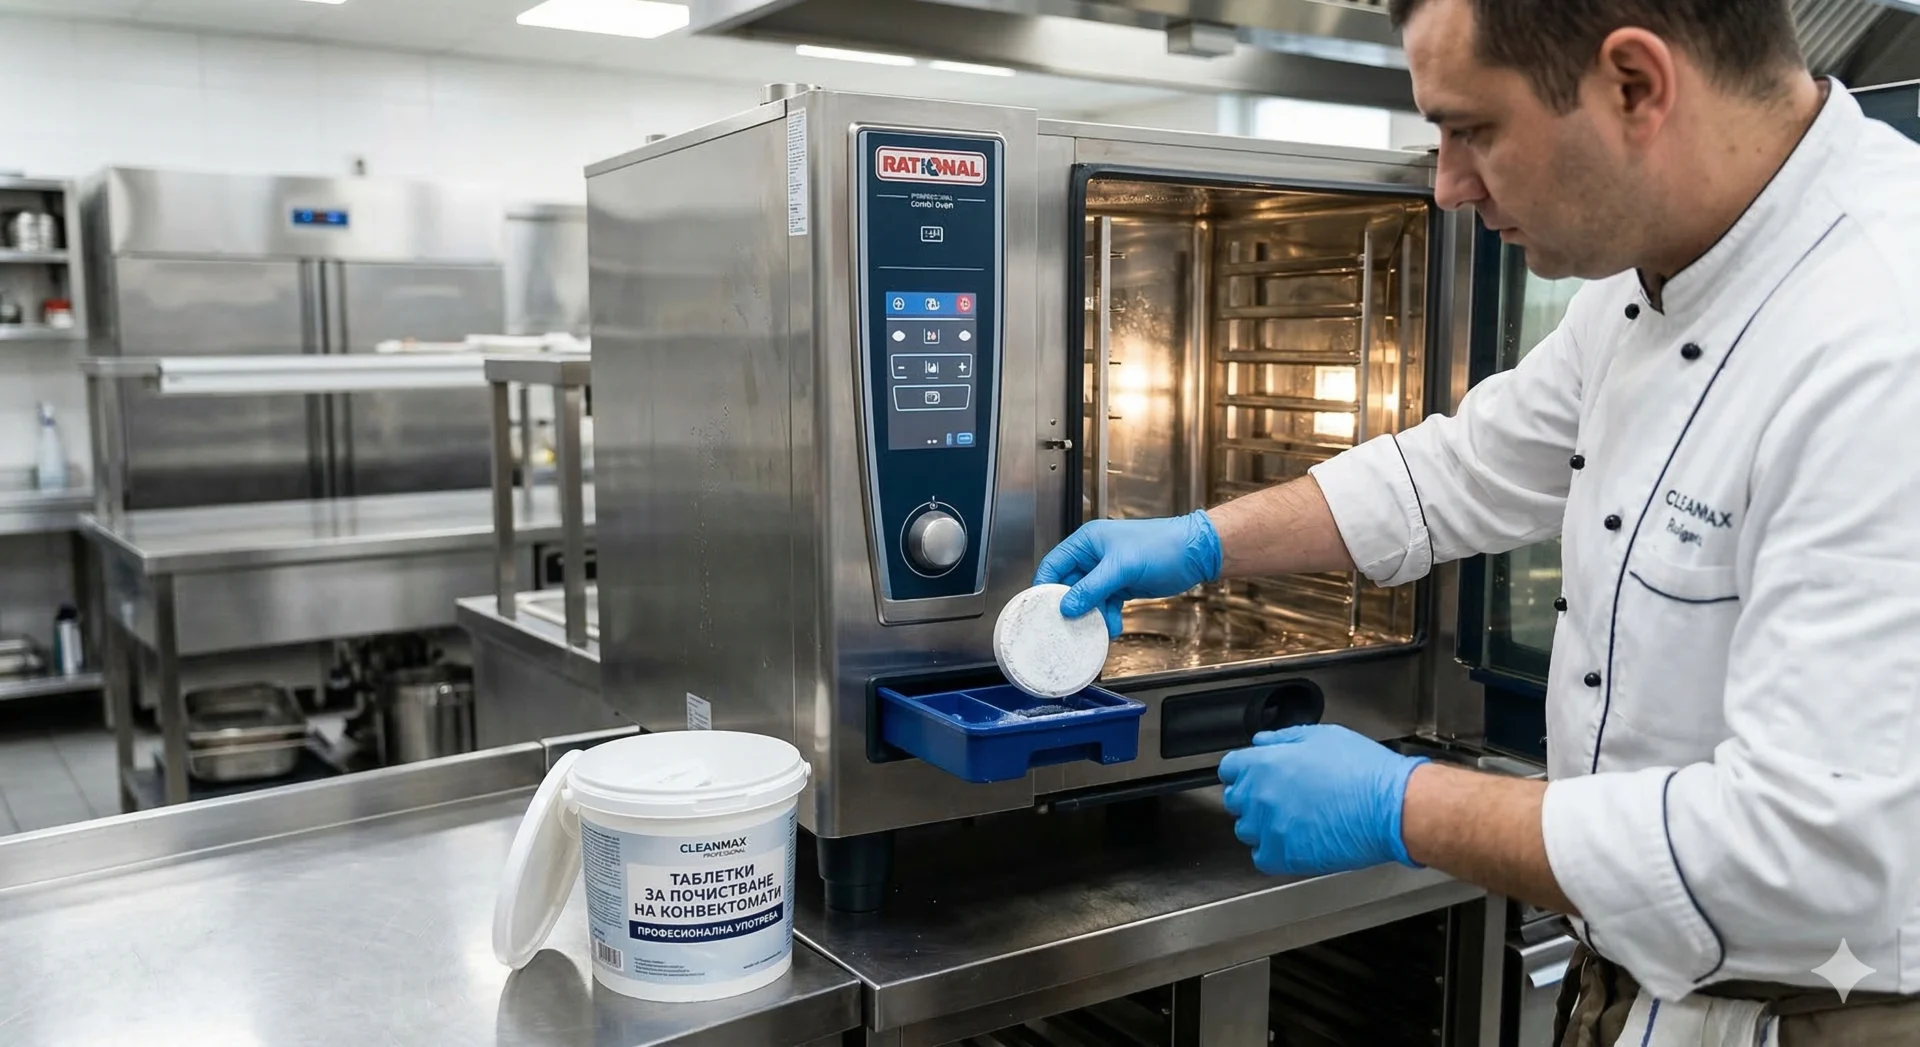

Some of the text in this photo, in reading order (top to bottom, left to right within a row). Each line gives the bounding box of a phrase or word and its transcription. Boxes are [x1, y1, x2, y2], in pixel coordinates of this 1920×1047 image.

[883, 155, 981, 177] RATIONAL
[935, 201, 954, 209] Oven
[680, 836, 747, 853] CLEANMAX
[670, 864, 755, 886] ТАБЛЕТКИ
[645, 873, 774, 902] ЗА ПОЧИСТВАНЕ
[634, 885, 782, 919] НА КОНВЕКТОМАТИ
[637, 910, 779, 939] ПРОФЕСИОНАЛНА УПОТРЕБА
